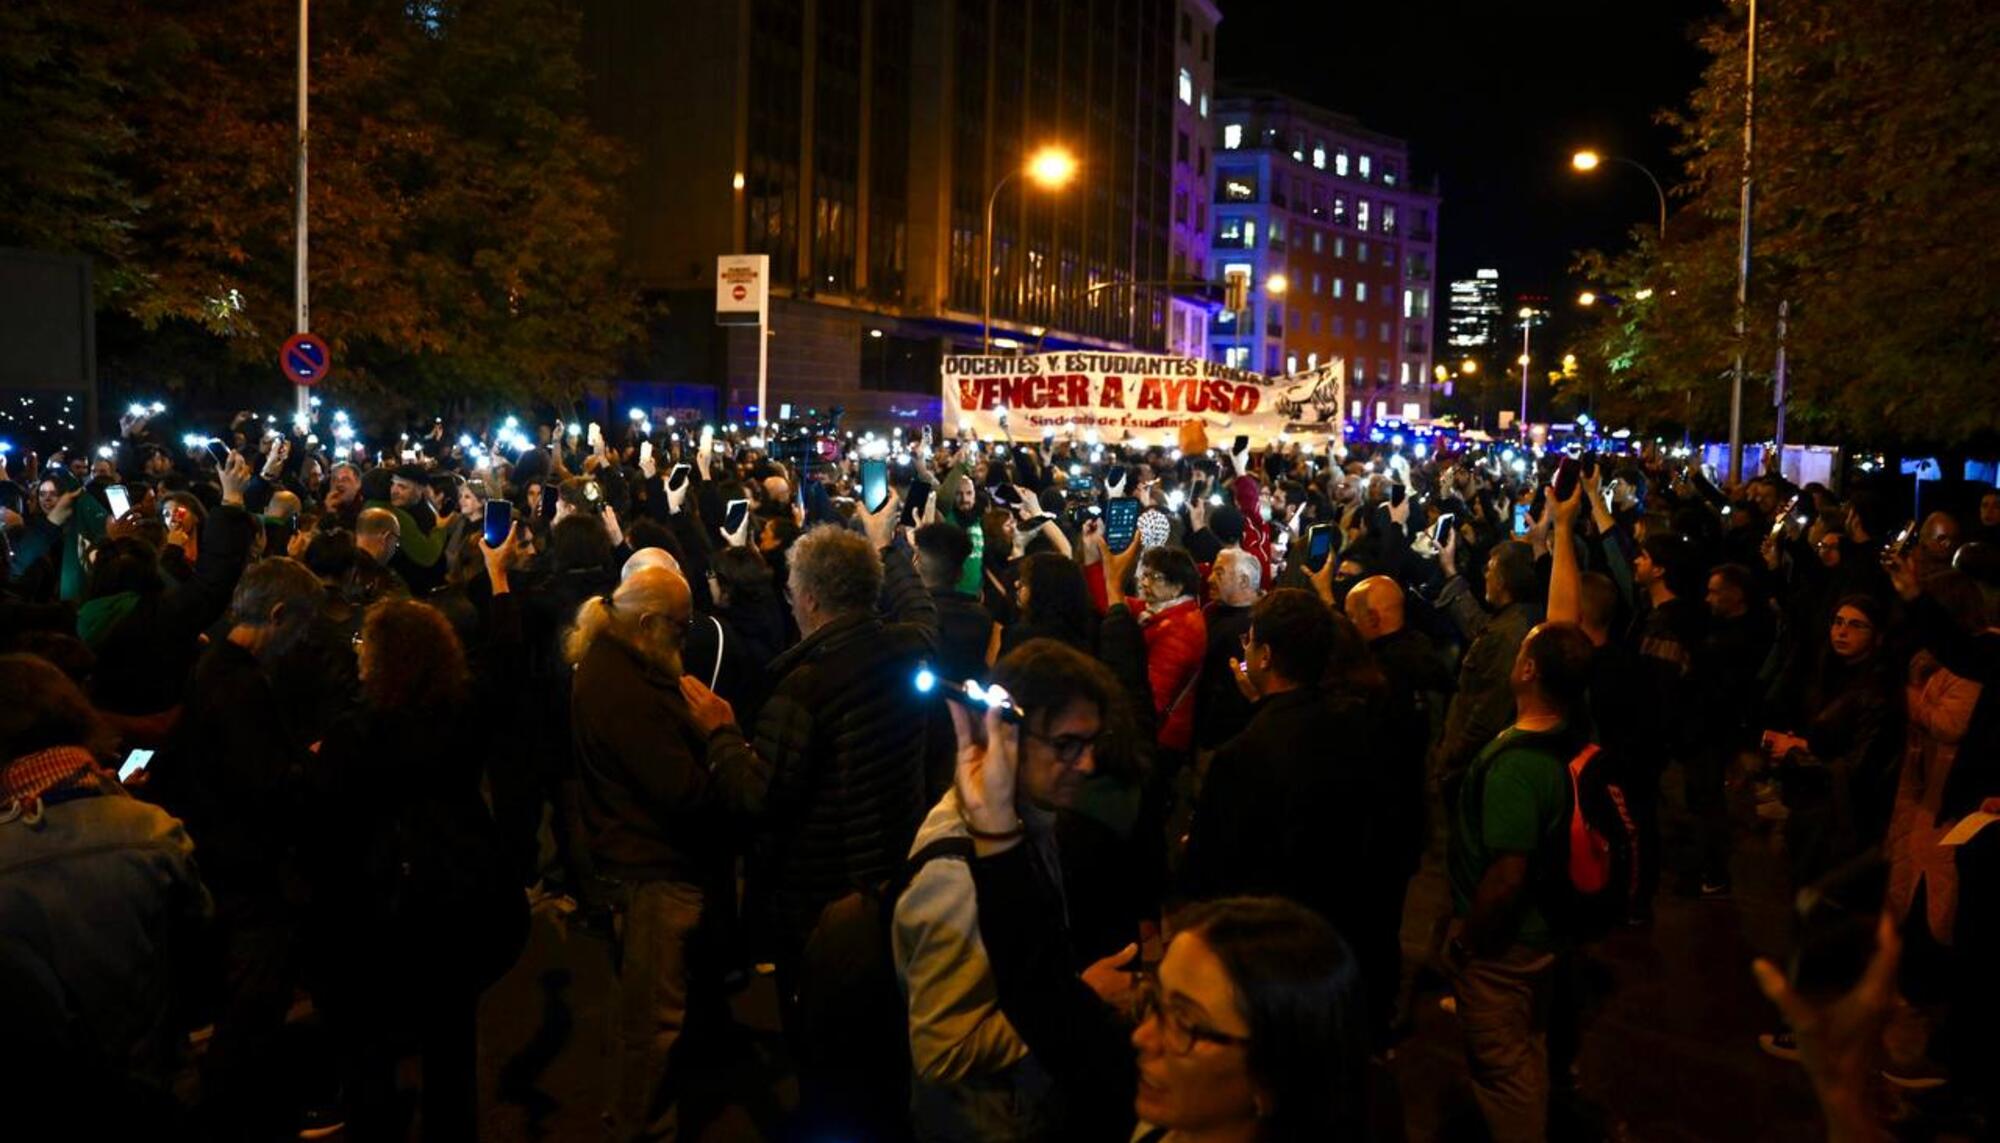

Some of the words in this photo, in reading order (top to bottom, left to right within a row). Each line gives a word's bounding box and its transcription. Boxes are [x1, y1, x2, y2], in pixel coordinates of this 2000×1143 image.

[945, 356, 1040, 375] DOCENTES
[1065, 353, 1198, 376] ESTUDIANTES
[959, 374, 1090, 411] VENCER
[1099, 376, 1125, 409] A
[1137, 377, 1261, 416] AYUSO
[1098, 415, 1117, 427] de
